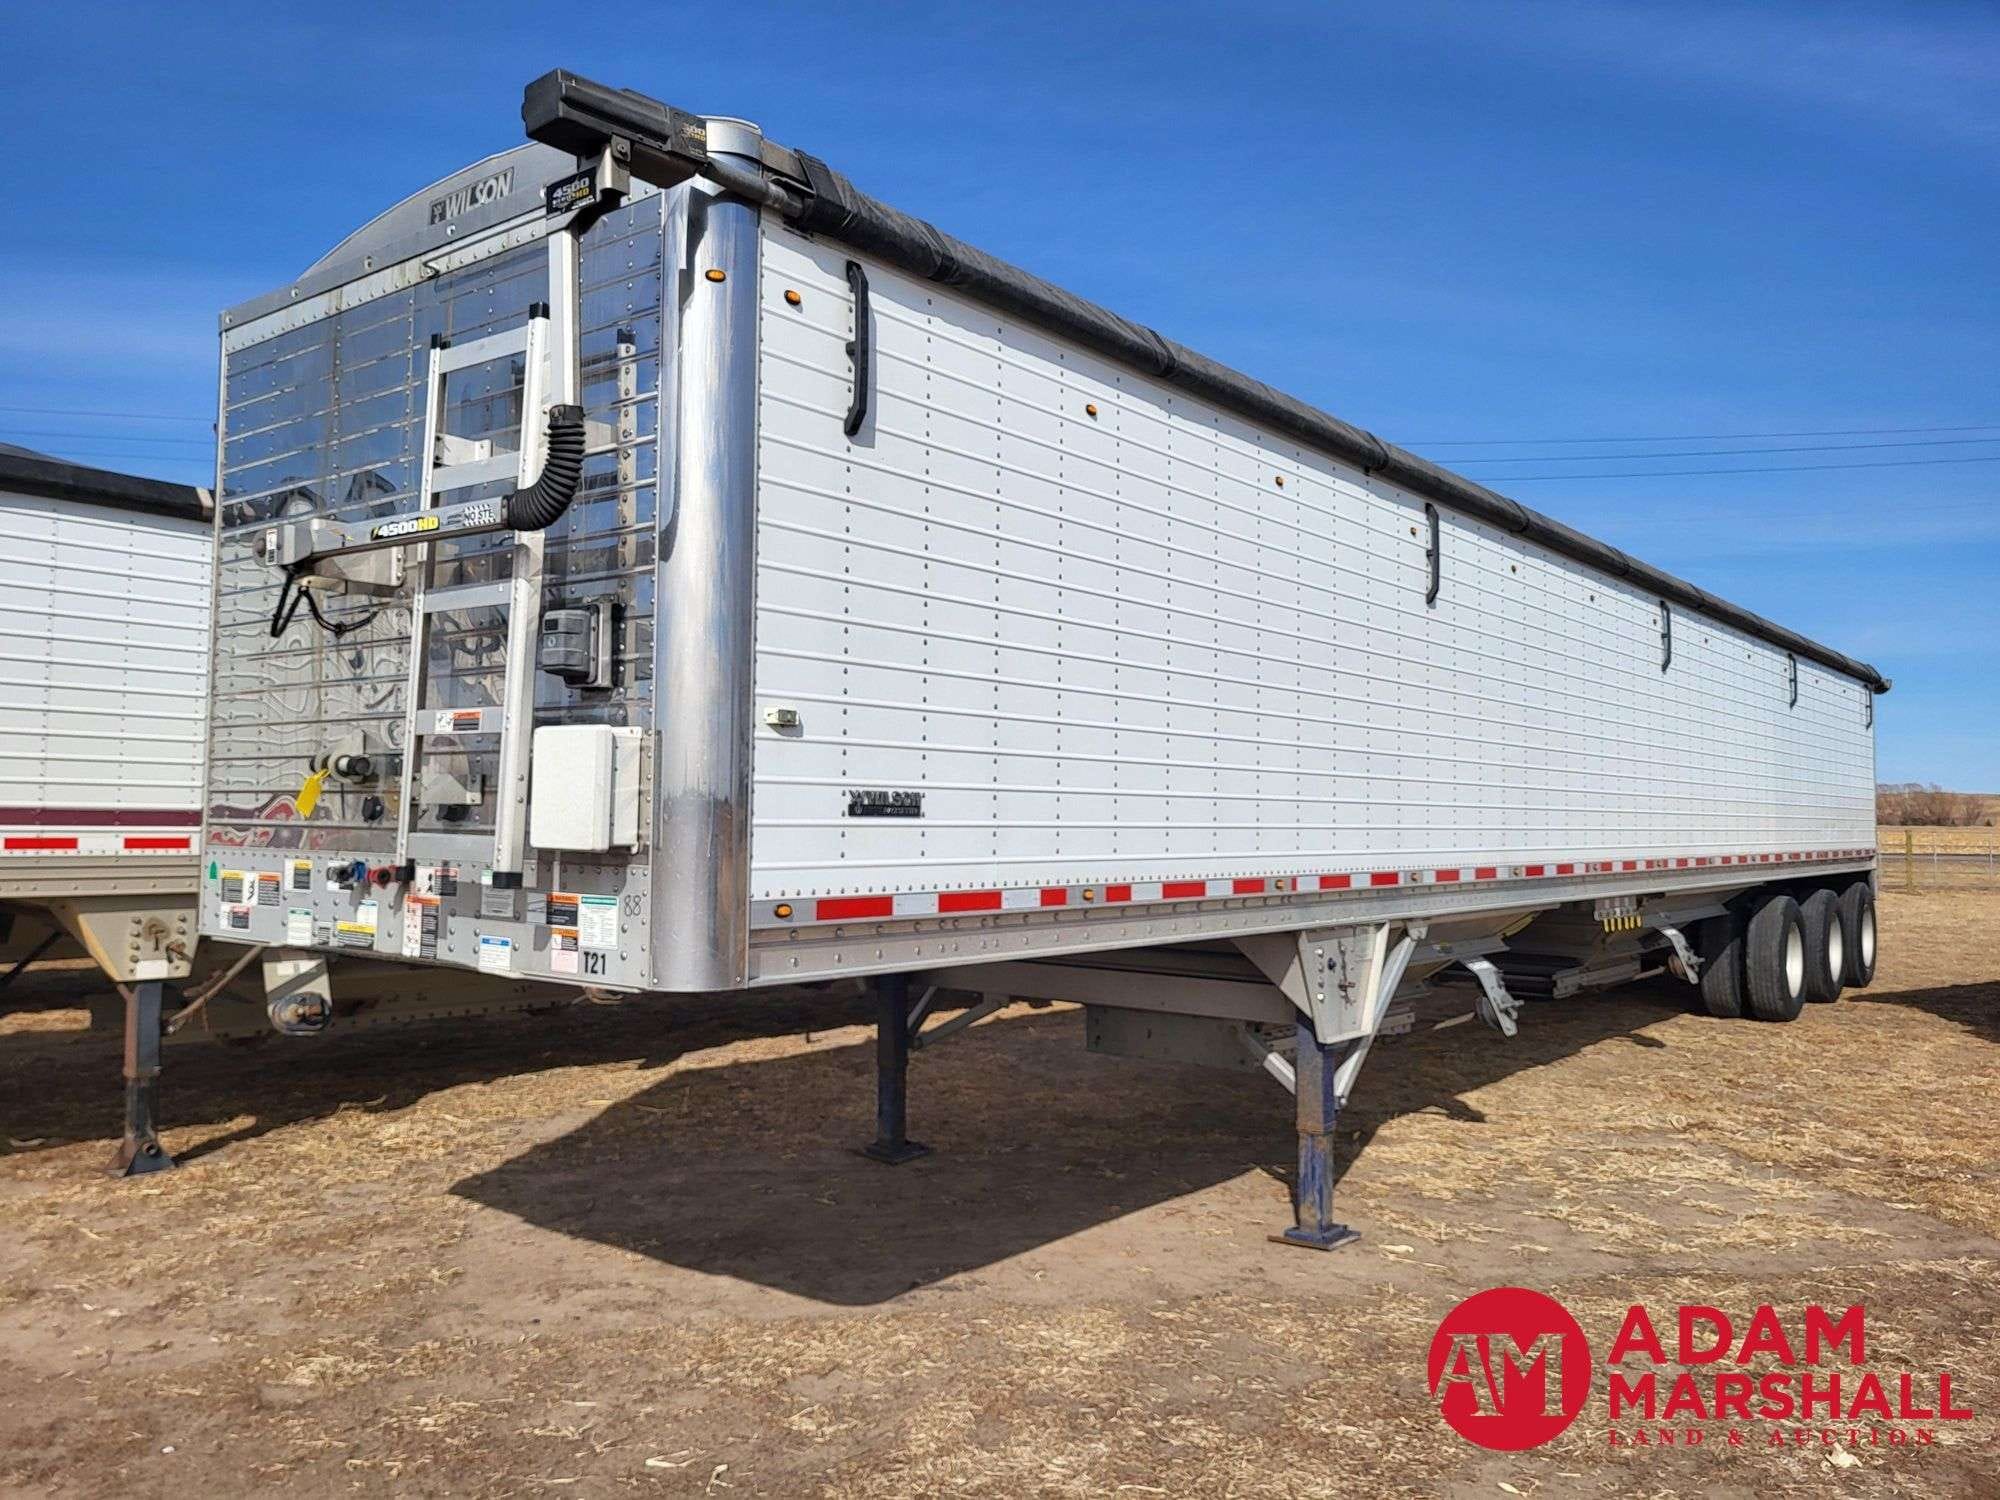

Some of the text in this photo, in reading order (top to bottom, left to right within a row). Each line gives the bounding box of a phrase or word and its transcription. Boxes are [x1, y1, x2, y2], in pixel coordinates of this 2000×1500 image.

[446, 171, 513, 220] WILSON
[552, 177, 590, 198] 4500
[583, 951, 607, 975] T21
